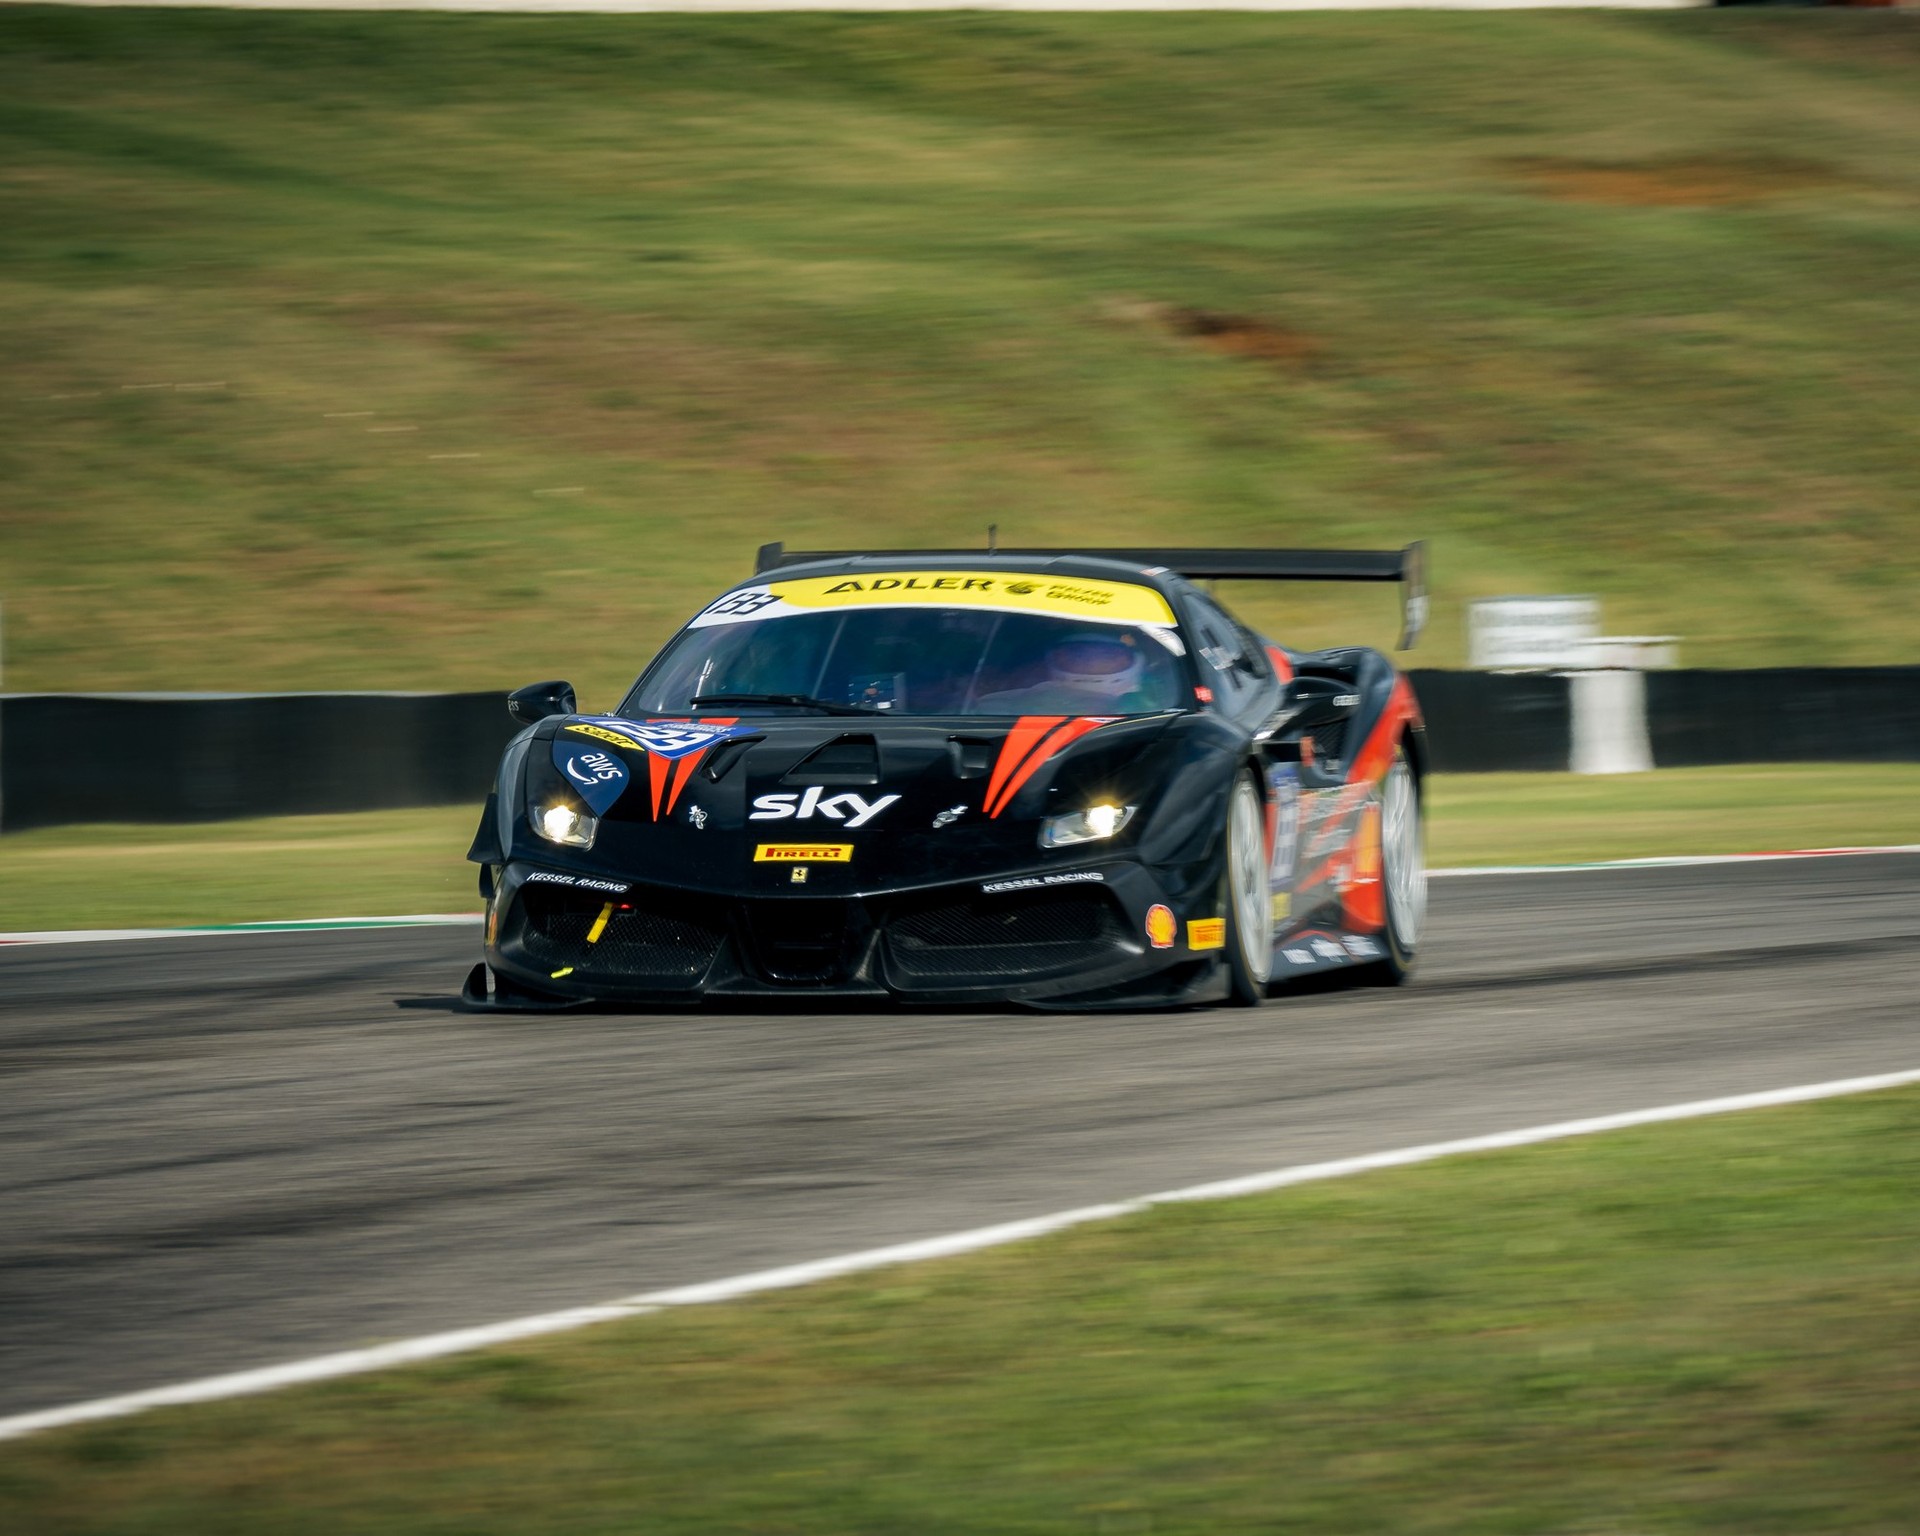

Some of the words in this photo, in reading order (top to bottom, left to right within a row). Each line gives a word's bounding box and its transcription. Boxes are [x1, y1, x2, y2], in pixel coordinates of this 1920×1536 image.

[822, 577, 994, 595] ADLER
[581, 752, 622, 780] aws
[749, 786, 902, 827] sky
[766, 848, 841, 857] PIRELLI
[526, 872, 576, 885] KESSEL
[575, 878, 628, 892] RACING
[983, 878, 1044, 892] KESSEL
[1044, 872, 1104, 884] RACING
